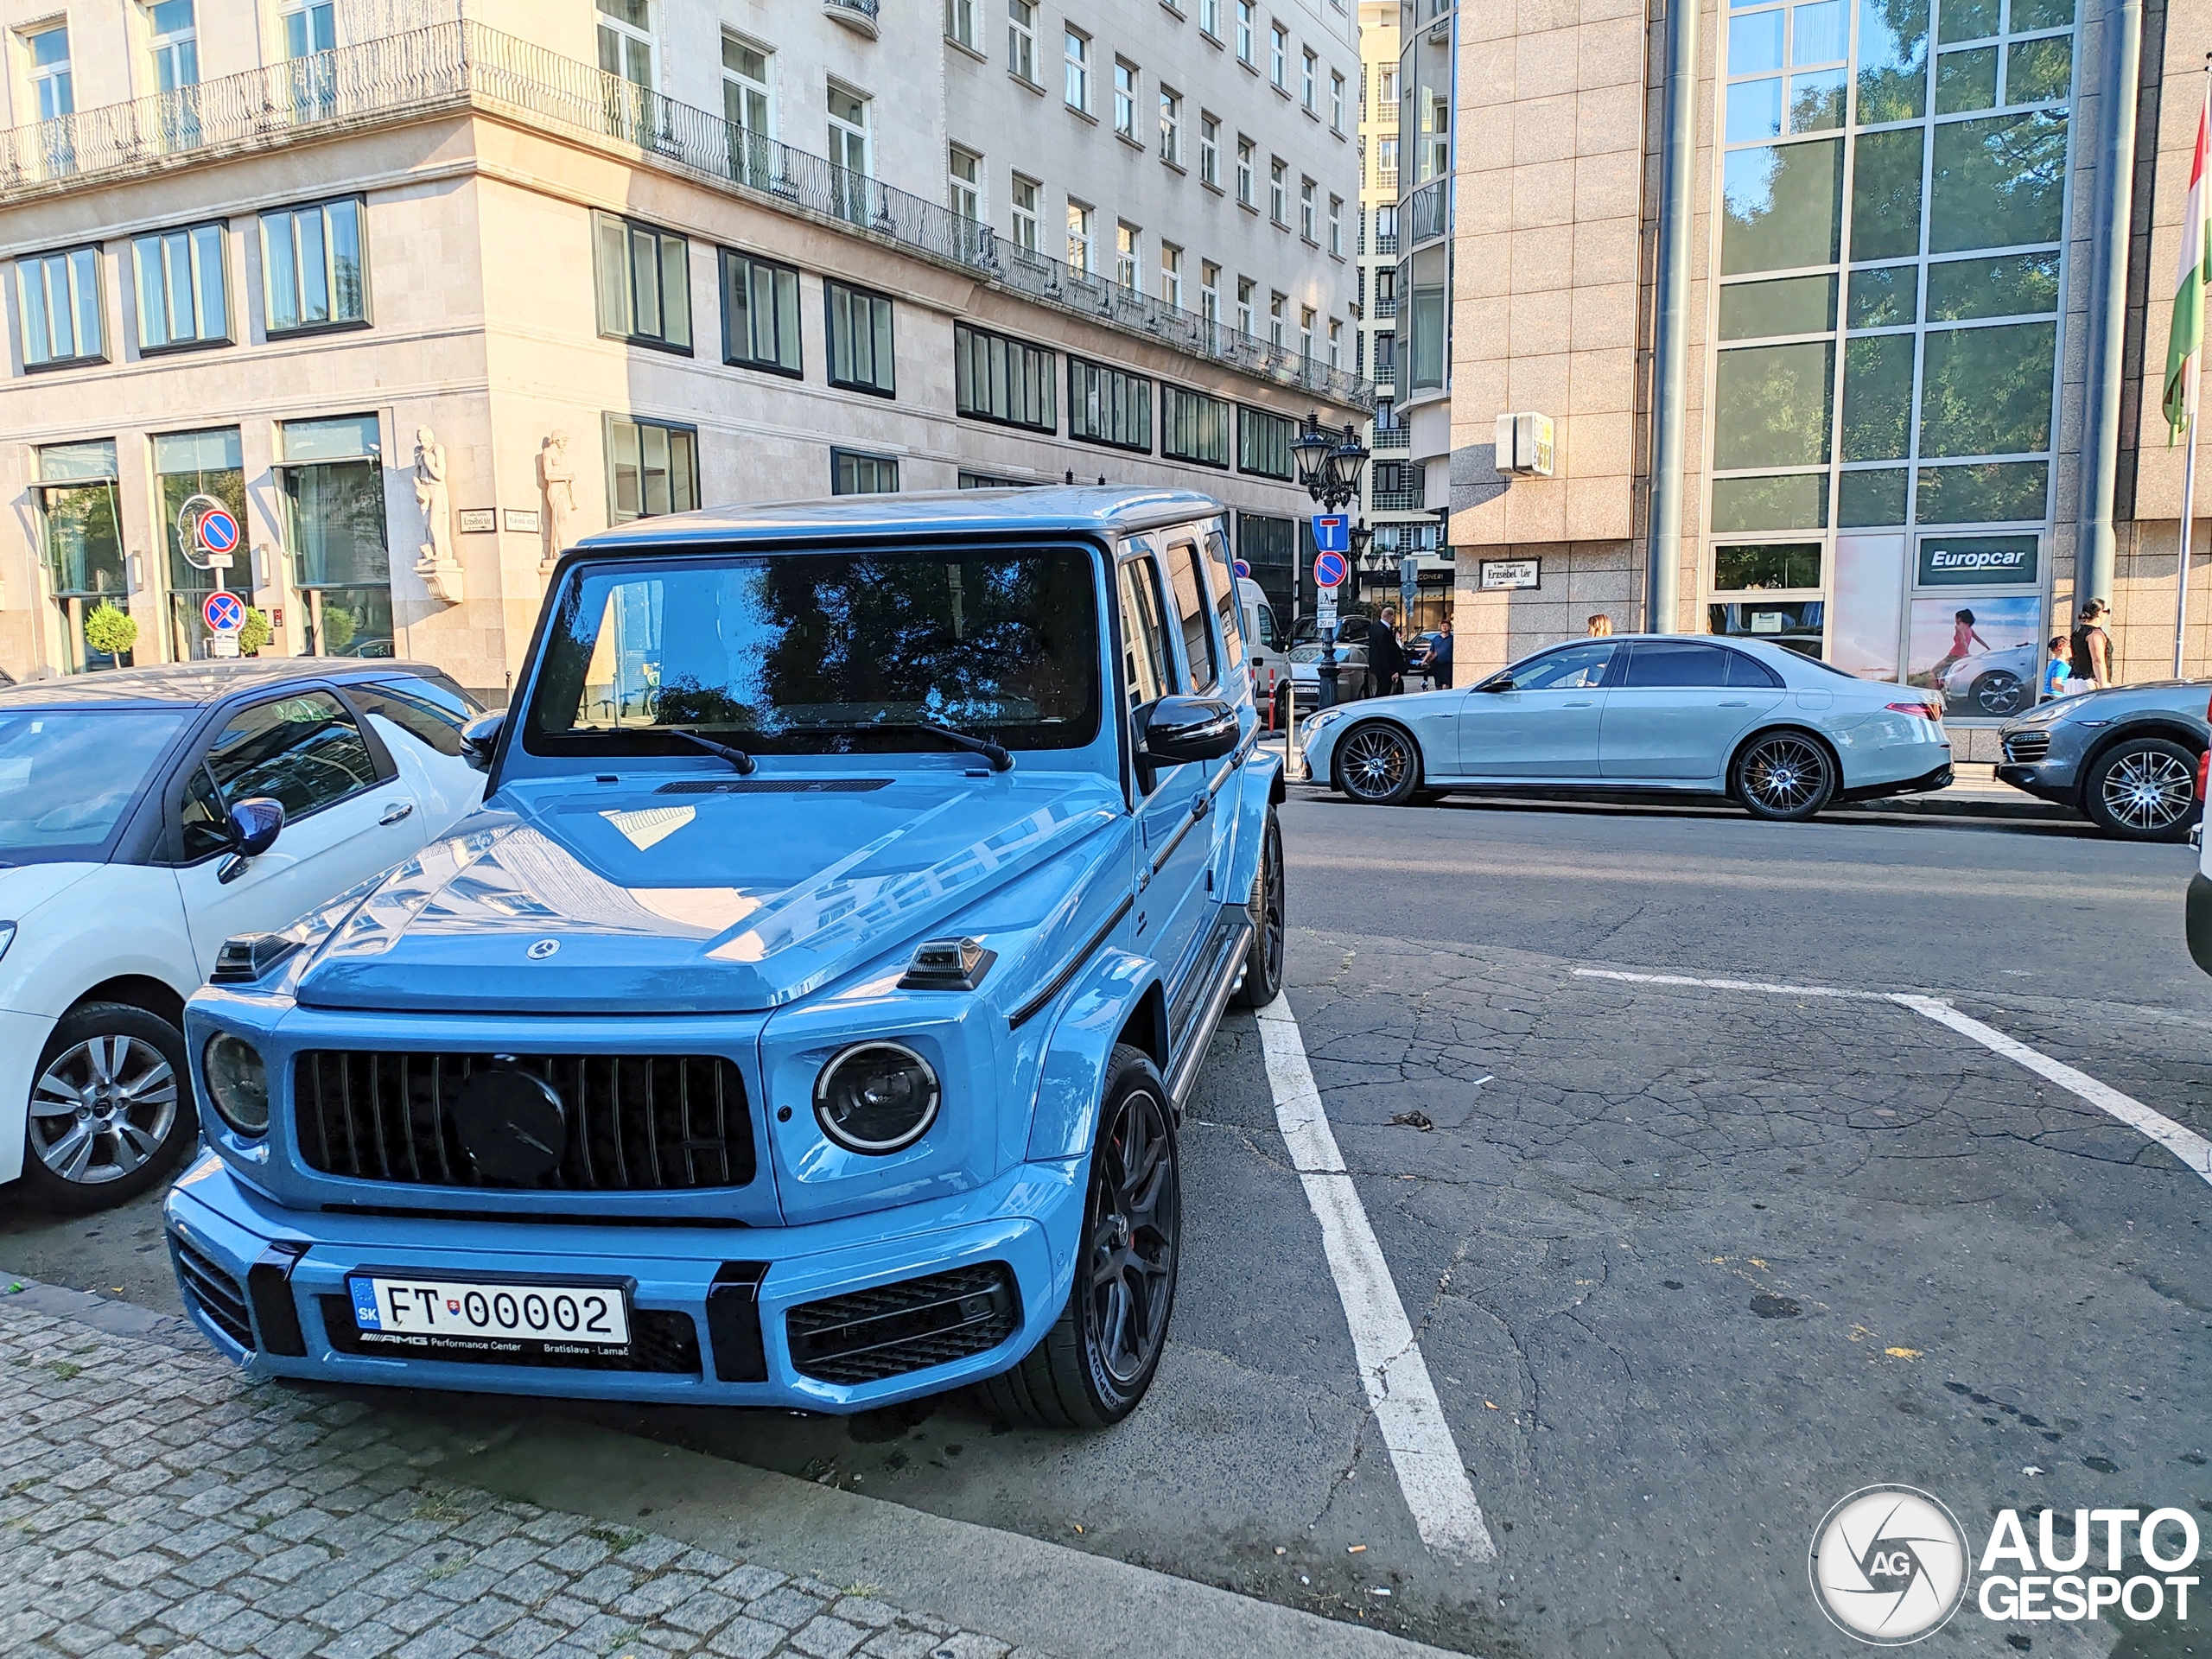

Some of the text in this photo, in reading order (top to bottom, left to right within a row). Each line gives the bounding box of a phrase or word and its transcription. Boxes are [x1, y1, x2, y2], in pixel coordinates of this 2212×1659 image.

[1931, 550, 2025, 570] Europcar
[358, 1307, 379, 1321] SK
[388, 1286, 612, 1333] FT 00002
[380, 1334, 522, 1351] AMG Performance Center
[543, 1344, 589, 1355] Bratislava
[597, 1345, 629, 1357] Lamač
